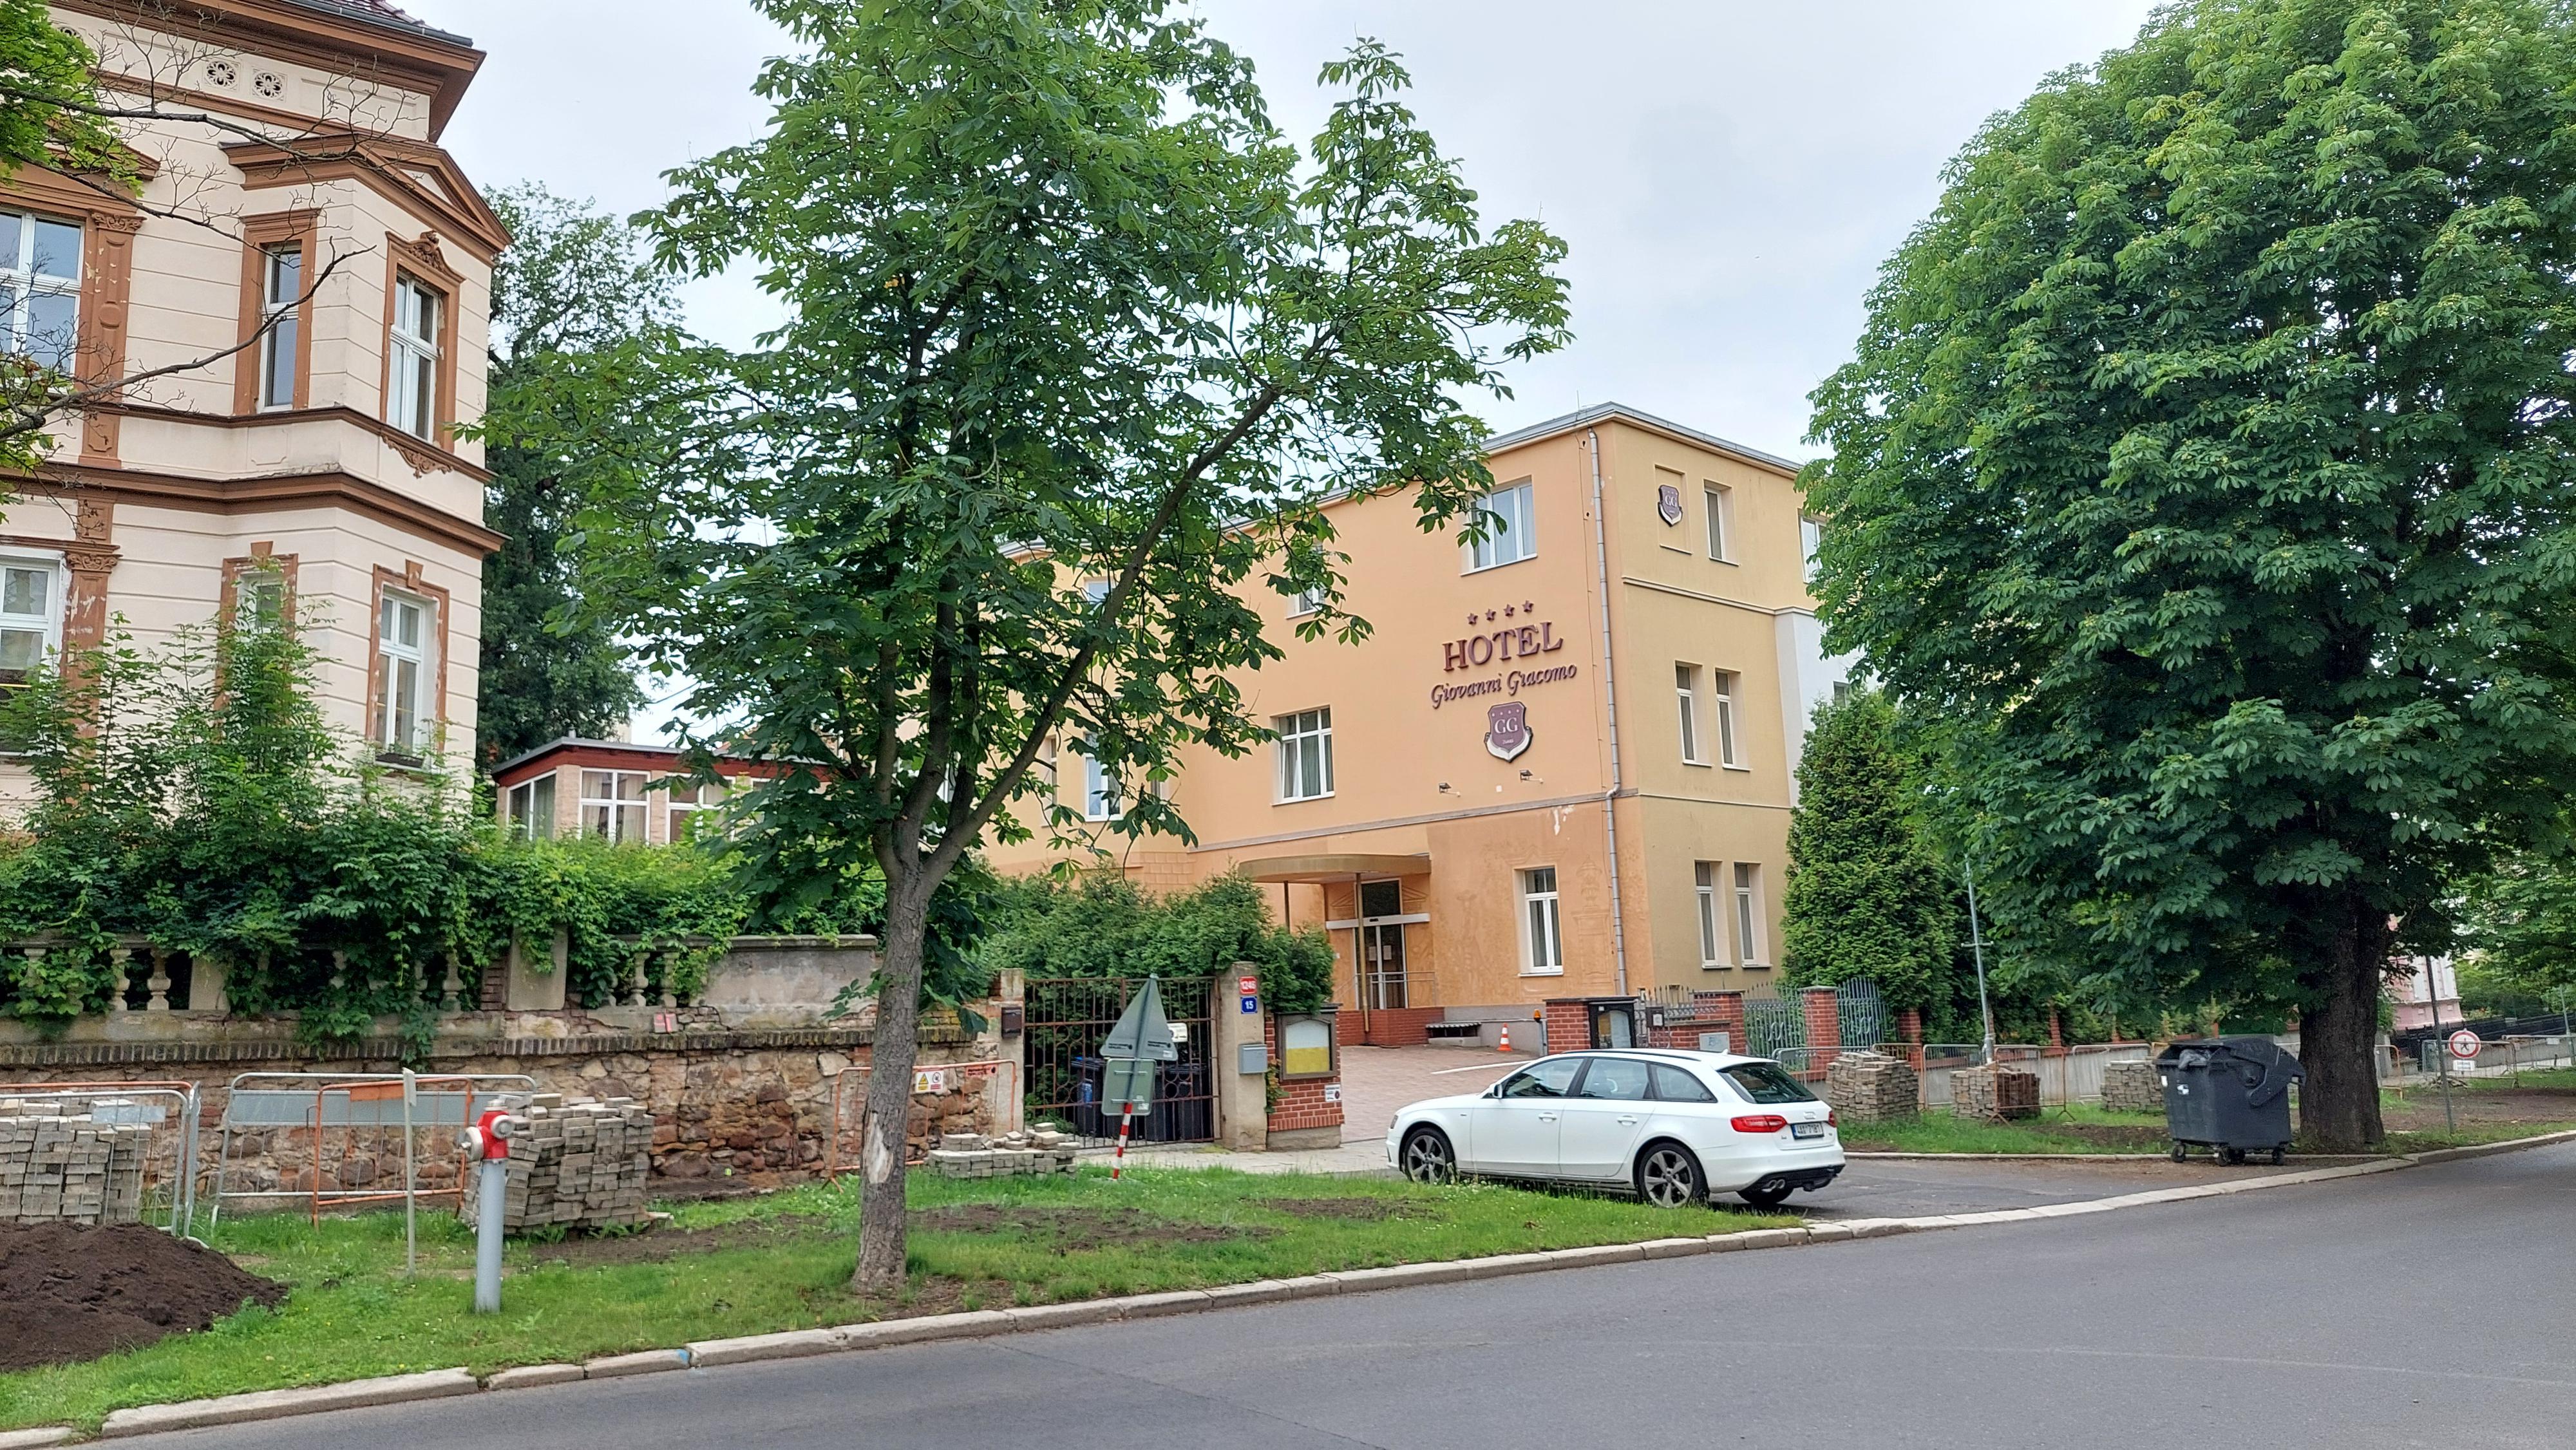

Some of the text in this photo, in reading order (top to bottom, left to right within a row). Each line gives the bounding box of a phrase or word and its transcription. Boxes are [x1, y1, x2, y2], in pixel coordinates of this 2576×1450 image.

[1442, 621, 1564, 672] HOTEL
[1431, 664, 1577, 709] Giovanni Giacomo
[1495, 717, 1518, 734] GG
[1245, 1001, 1253, 1010] 15
